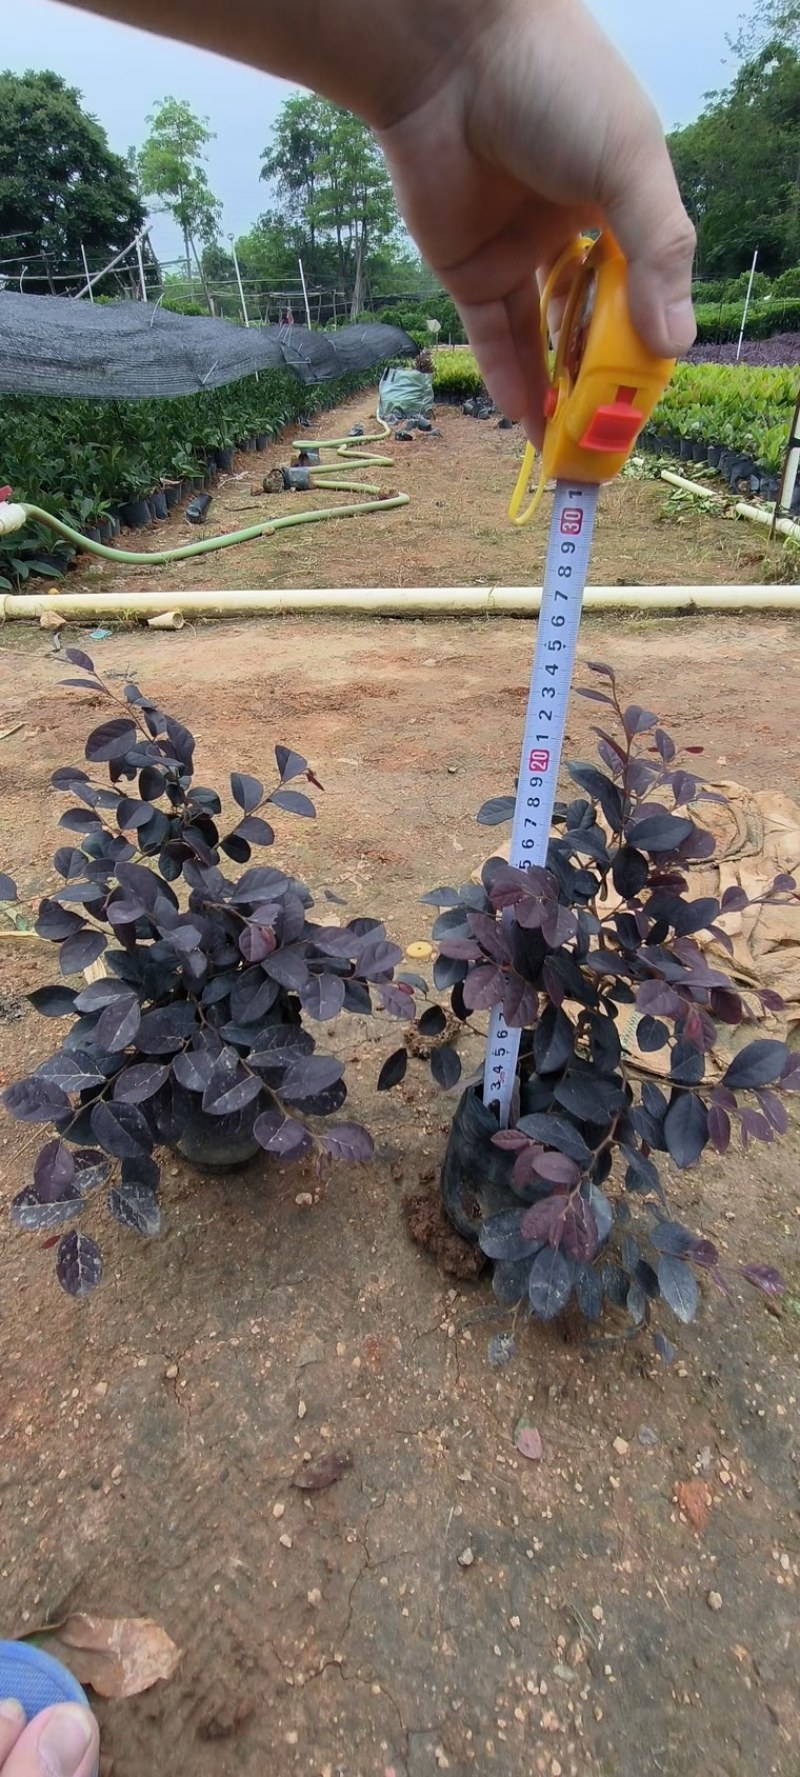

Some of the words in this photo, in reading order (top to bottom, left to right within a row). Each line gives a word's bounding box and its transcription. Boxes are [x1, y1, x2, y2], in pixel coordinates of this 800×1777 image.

[568, 491, 582, 499] 1
[562, 511, 581, 532] 30
[561, 542, 575, 554] 9
[558, 566, 572, 578] 8
[555, 590, 568, 601] 7
[551, 615, 565, 627] 6
[548, 640, 562, 651] 5
[545, 664, 558, 676] 4
[542, 687, 555, 698] 3
[539, 710, 552, 721] 2
[536, 734, 549, 742] 1
[530, 751, 548, 770] 20
[530, 777, 543, 787] 9
[527, 797, 540, 808] 8
[524, 818, 537, 828] 7
[522, 839, 534, 849] 6
[519, 860, 531, 869] 5
[497, 1030, 509, 1039] 6
[494, 1047, 506, 1057] 5
[492, 1065, 503, 1074] 4
[491, 1080, 501, 1091] 3
